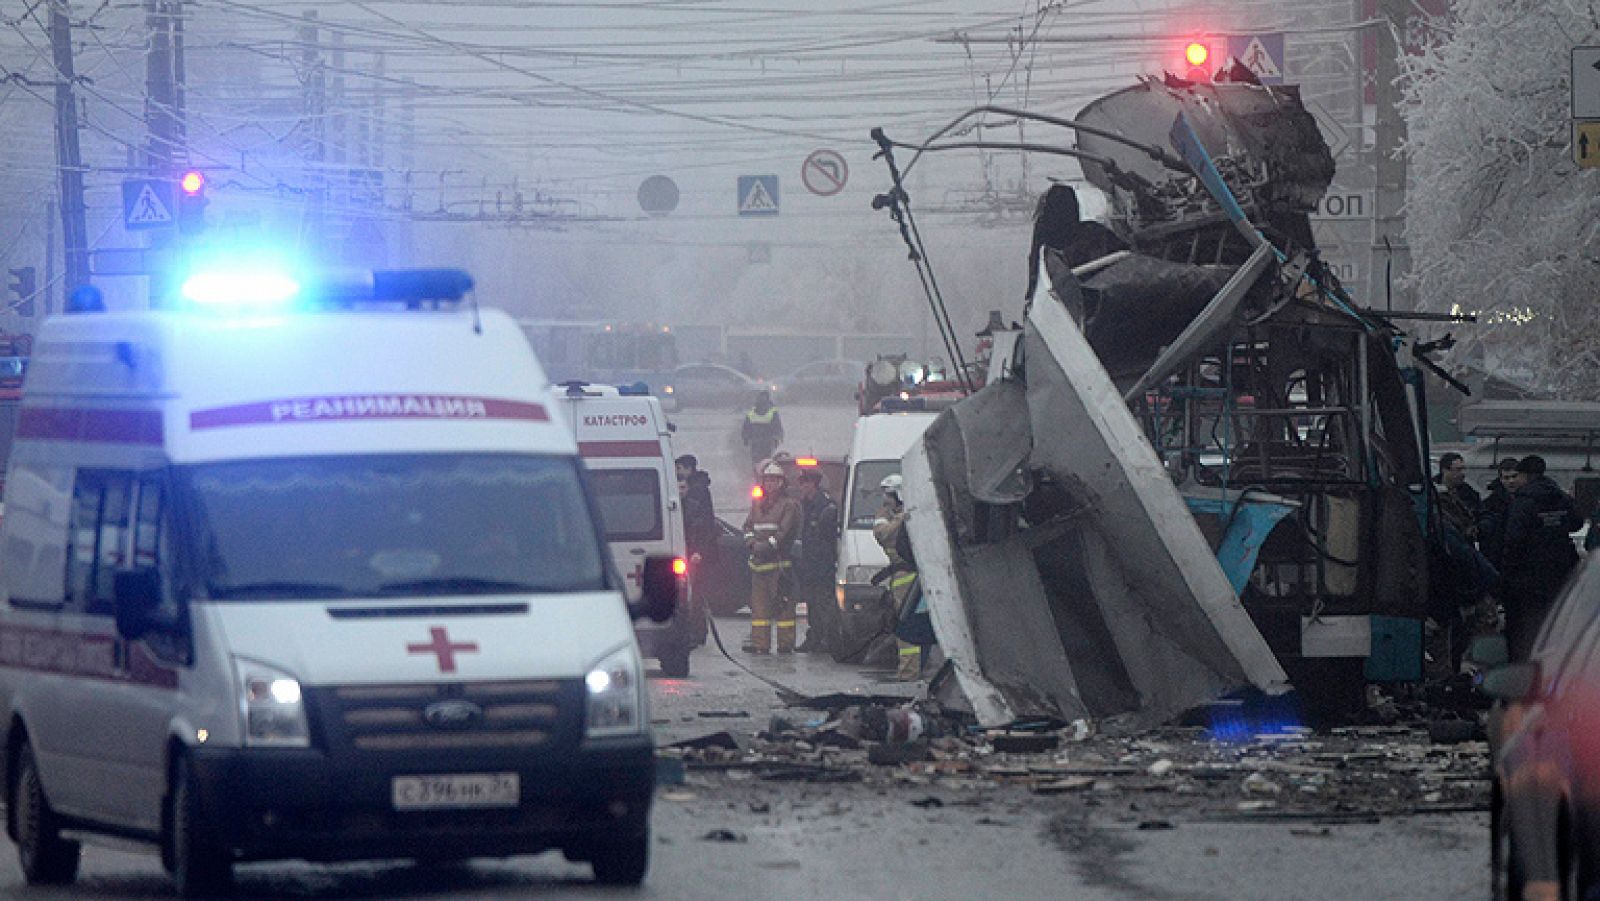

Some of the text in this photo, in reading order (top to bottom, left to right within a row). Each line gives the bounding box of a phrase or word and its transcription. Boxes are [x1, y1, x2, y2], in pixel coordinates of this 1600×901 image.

[1315, 194, 1362, 216] ТОП
[272, 397, 486, 420] РЕАНИМАЦИЯ
[583, 414, 648, 427] КАТАСТРОФ
